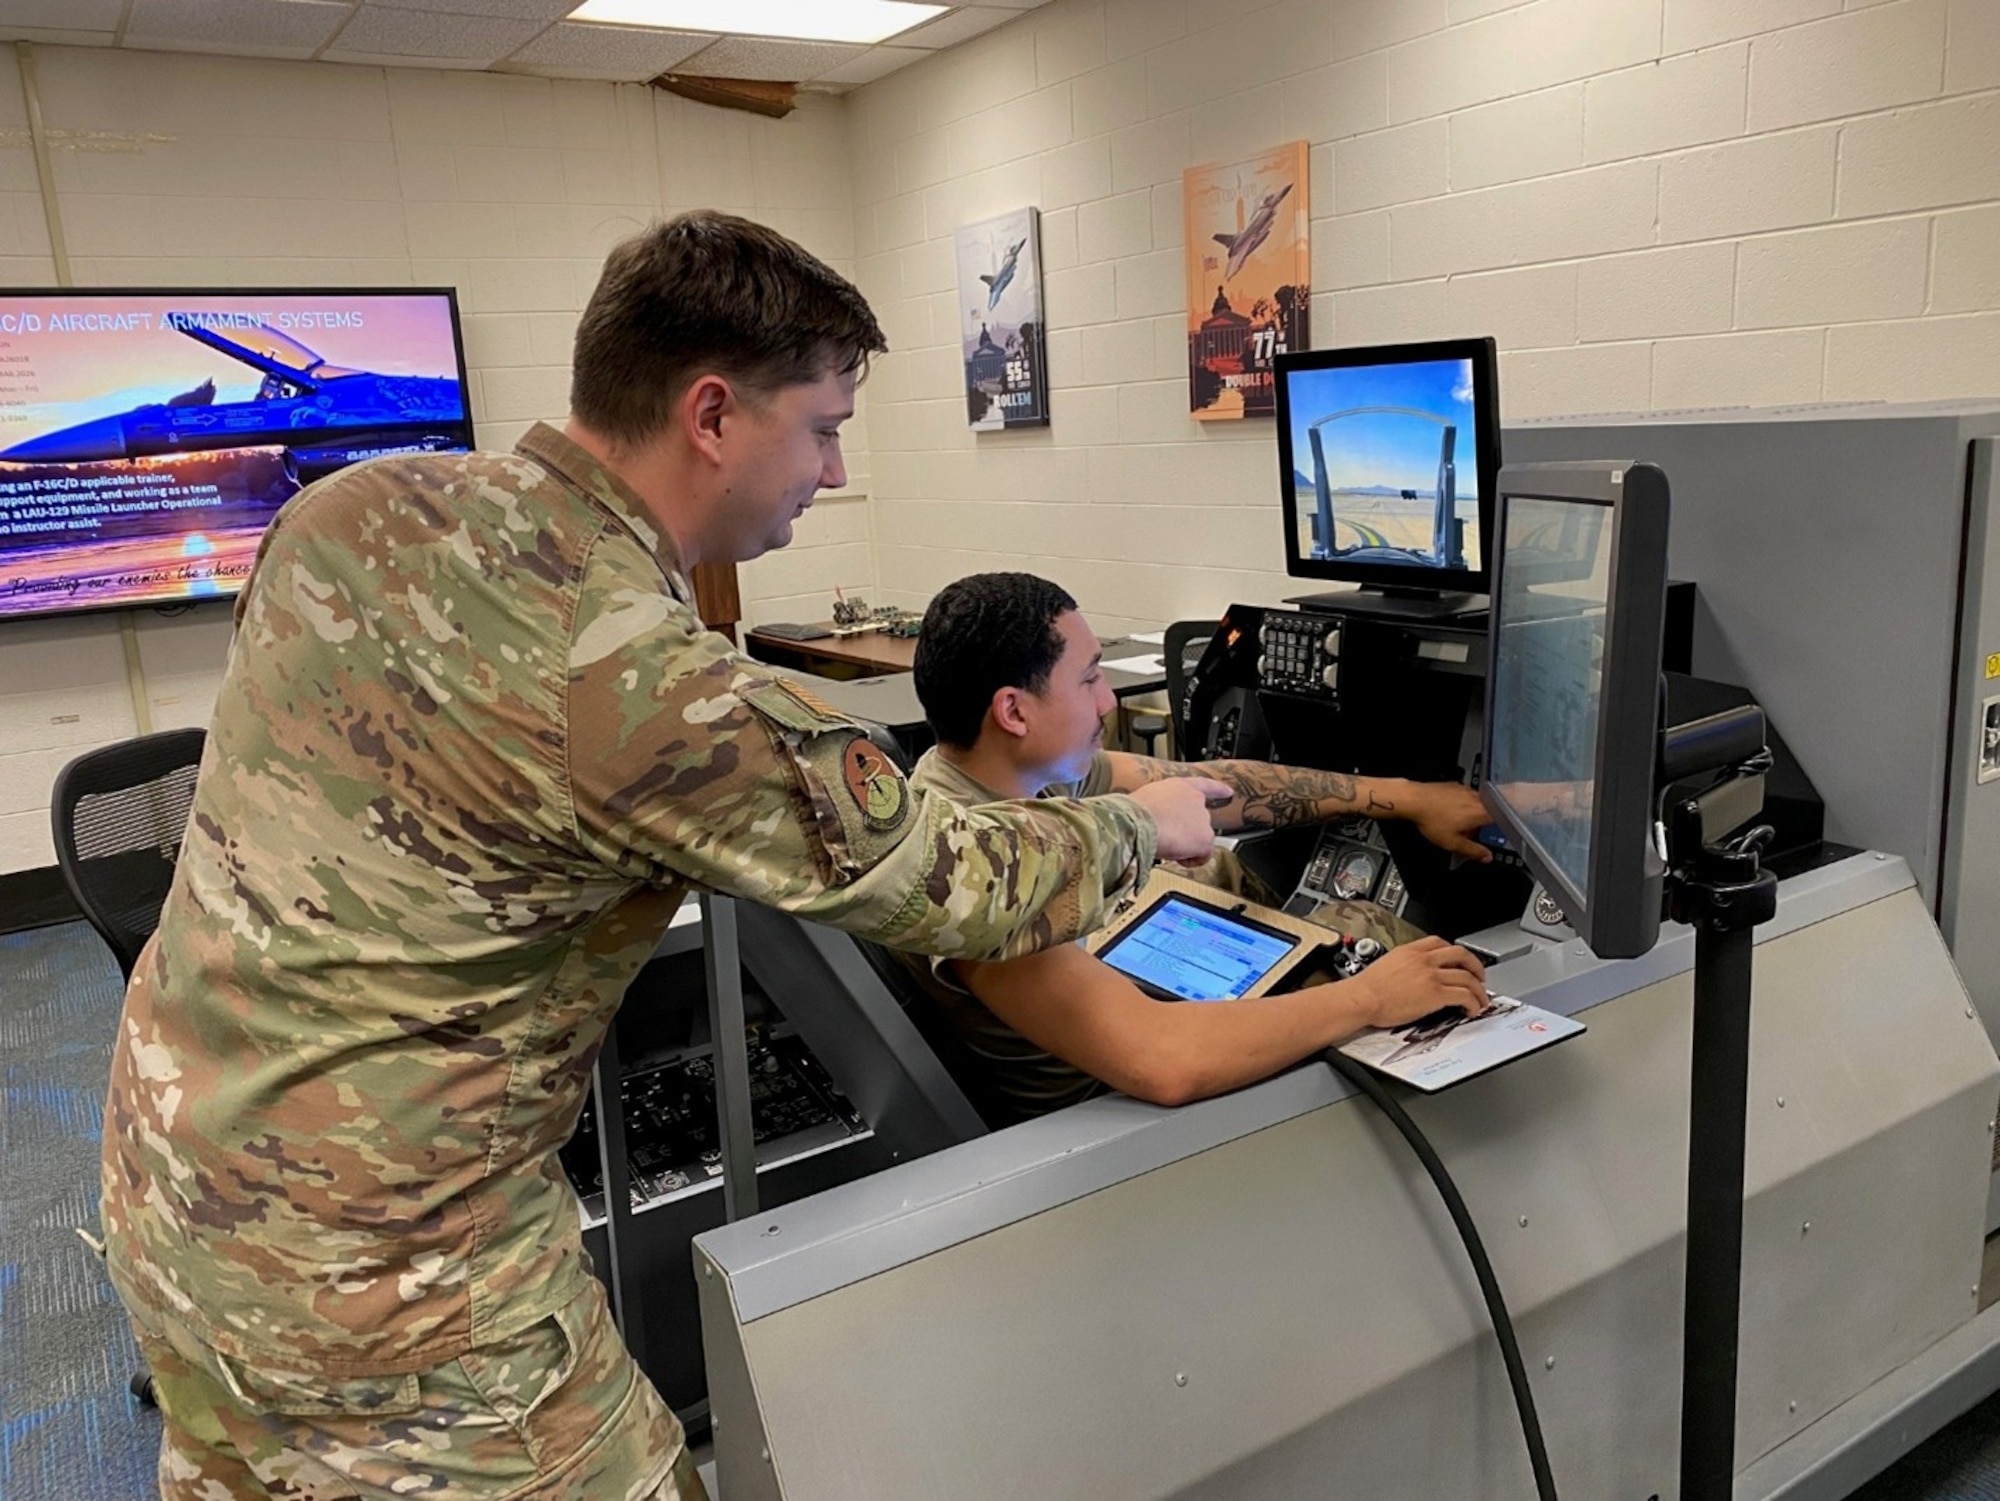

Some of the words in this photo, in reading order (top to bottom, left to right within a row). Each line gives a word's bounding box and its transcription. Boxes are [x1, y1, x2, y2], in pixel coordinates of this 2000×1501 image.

[0, 312, 41, 335] C/D
[49, 312, 152, 331] AIRCRAFT
[159, 311, 273, 330] ARMAMENT
[279, 310, 364, 328] SYSTEMS
[1253, 331, 1275, 360] 77
[1006, 360, 1022, 382] 55
[17, 481, 33, 491] an
[33, 477, 79, 491] F-16C/D
[80, 474, 136, 489] applicable
[136, 473, 176, 484] trainer,
[101, 488, 122, 500] and
[124, 486, 168, 498] working
[168, 486, 181, 495] as
[189, 484, 218, 494] team
[12, 510, 22, 519] a
[22, 506, 70, 518] LAU-129
[71, 502, 110, 515] Missile
[110, 499, 160, 513] Launcher
[160, 495, 222, 510] Operational
[11, 520, 66, 534] instructor
[67, 517, 102, 530] assist.
[177, 563, 200, 580] the
